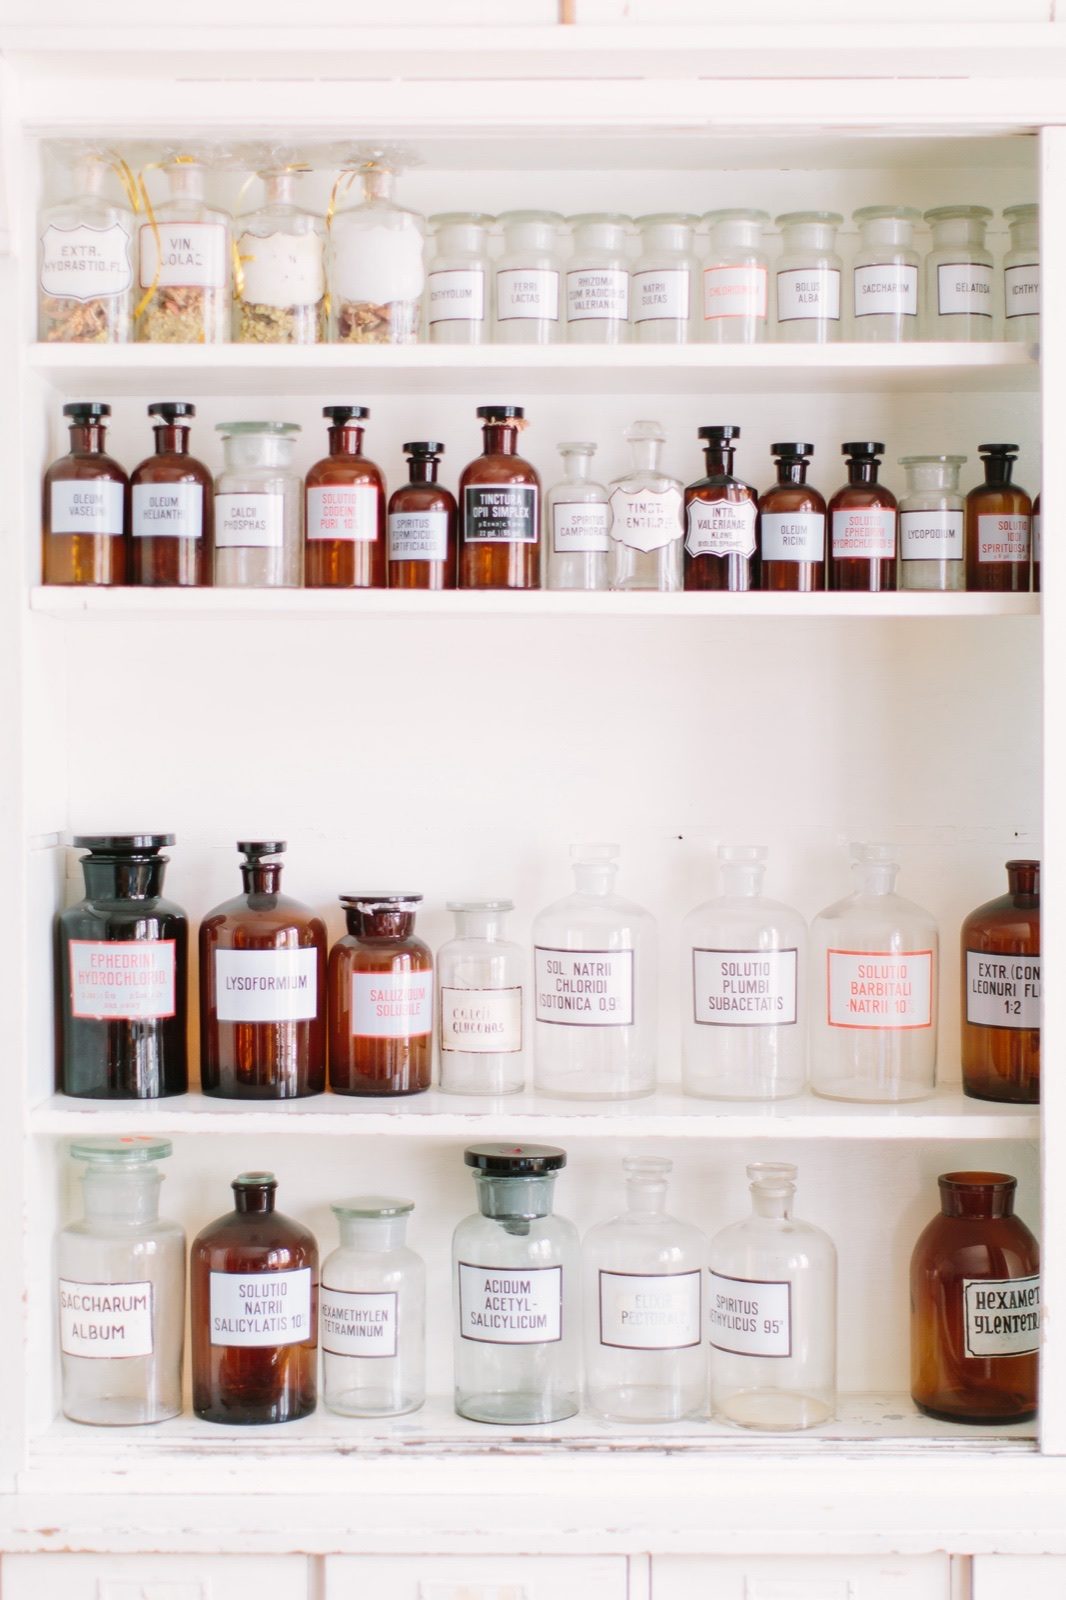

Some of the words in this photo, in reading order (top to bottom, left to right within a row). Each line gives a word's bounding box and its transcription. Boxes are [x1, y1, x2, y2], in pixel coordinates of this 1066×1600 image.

[168, 238, 194, 251] VIN.
[149, 497, 179, 508] OLEUM
[479, 493, 523, 505] TINCTURA
[491, 506, 530, 519] SIMPLEX
[223, 519, 267, 531] PHOSPHAS
[396, 518, 431, 529] SPIRITUS
[779, 524, 809, 535] OLEUM
[90, 952, 156, 969] EPHEDRINI
[573, 962, 612, 976] NATRII
[720, 962, 771, 977] SOLUTIO
[857, 964, 908, 980] SOLUTIO
[225, 975, 308, 992] LYSOFORMIUM
[555, 978, 608, 994] CHLORIDI
[722, 979, 770, 995] PLUMBI
[849, 980, 912, 997] BARBITALI
[972, 979, 1017, 997] LEONURI
[1024, 983, 1040, 998] FL
[708, 996, 785, 1012] SUBACETATIS
[1003, 999, 1022, 1015] 1:2
[239, 1282, 289, 1299] SOLUTIO
[483, 1278, 532, 1295] ACIDUM
[61, 1290, 149, 1312] SACCHARUM
[243, 1301, 283, 1317] NATRII
[485, 1296, 539, 1312] ACETYL-
[715, 1294, 760, 1316] SPIRITUS
[214, 1315, 288, 1333] SALICYLATIS
[470, 1310, 548, 1329] SALICYLICUM
[71, 1322, 127, 1341] ALBUM
[324, 1319, 385, 1338] TETRAMINUM
